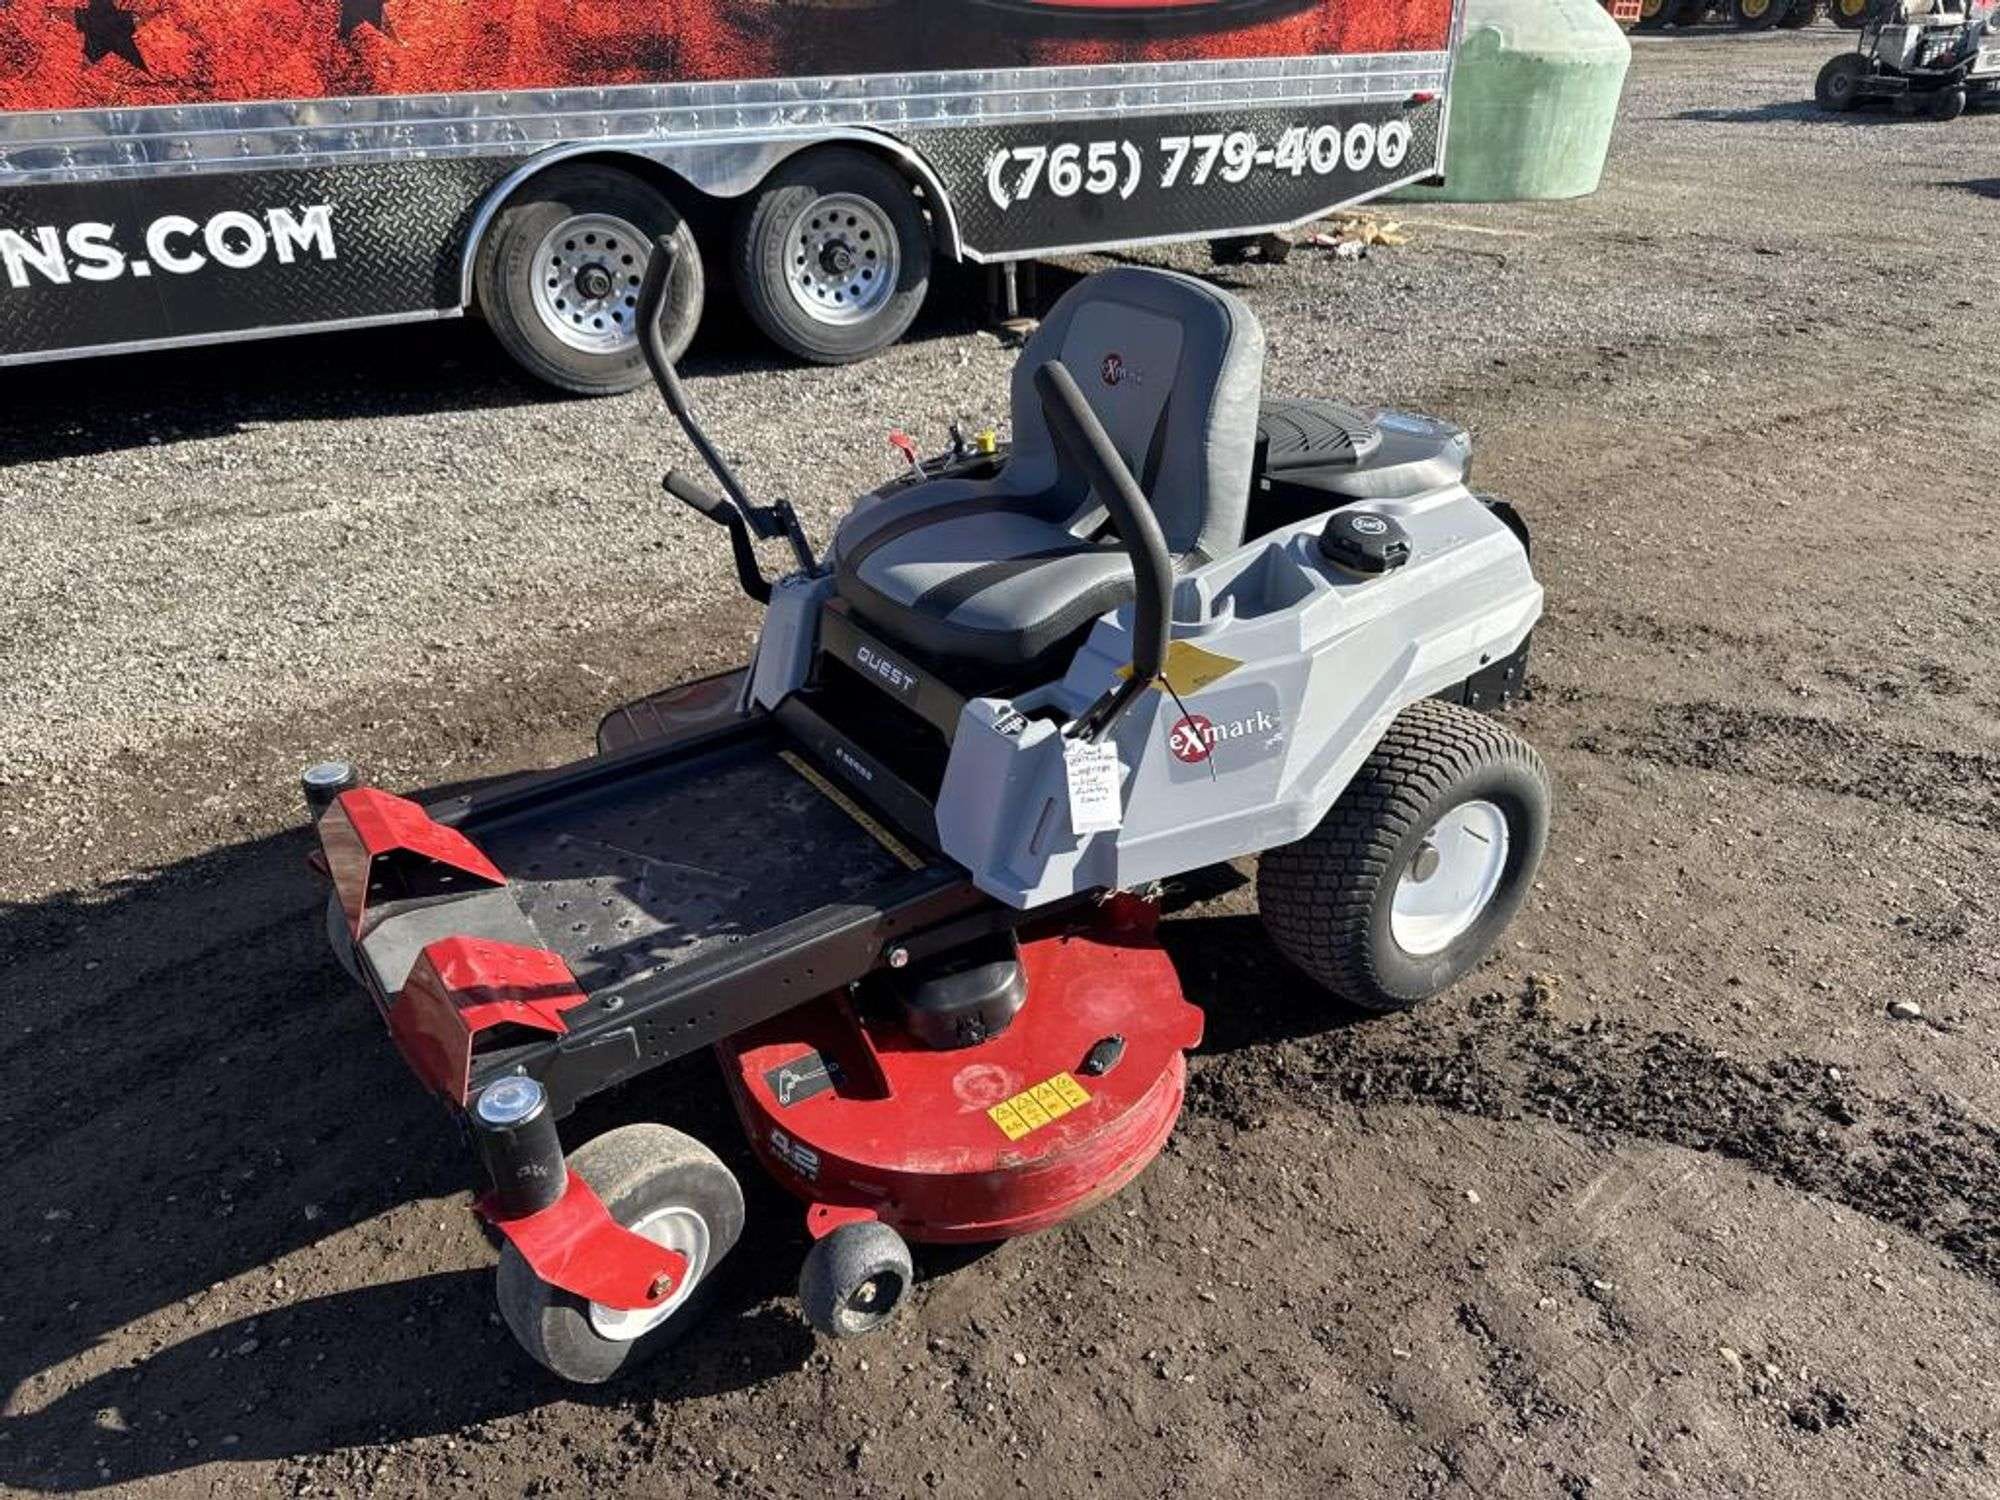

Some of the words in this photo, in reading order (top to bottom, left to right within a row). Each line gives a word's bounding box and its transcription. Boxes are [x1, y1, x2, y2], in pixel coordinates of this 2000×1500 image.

[987, 140, 1141, 211] (765)
[1160, 120, 1411, 188] 779-4000
[857, 646, 914, 691] QUEST
[771, 1129, 819, 1176] 42
